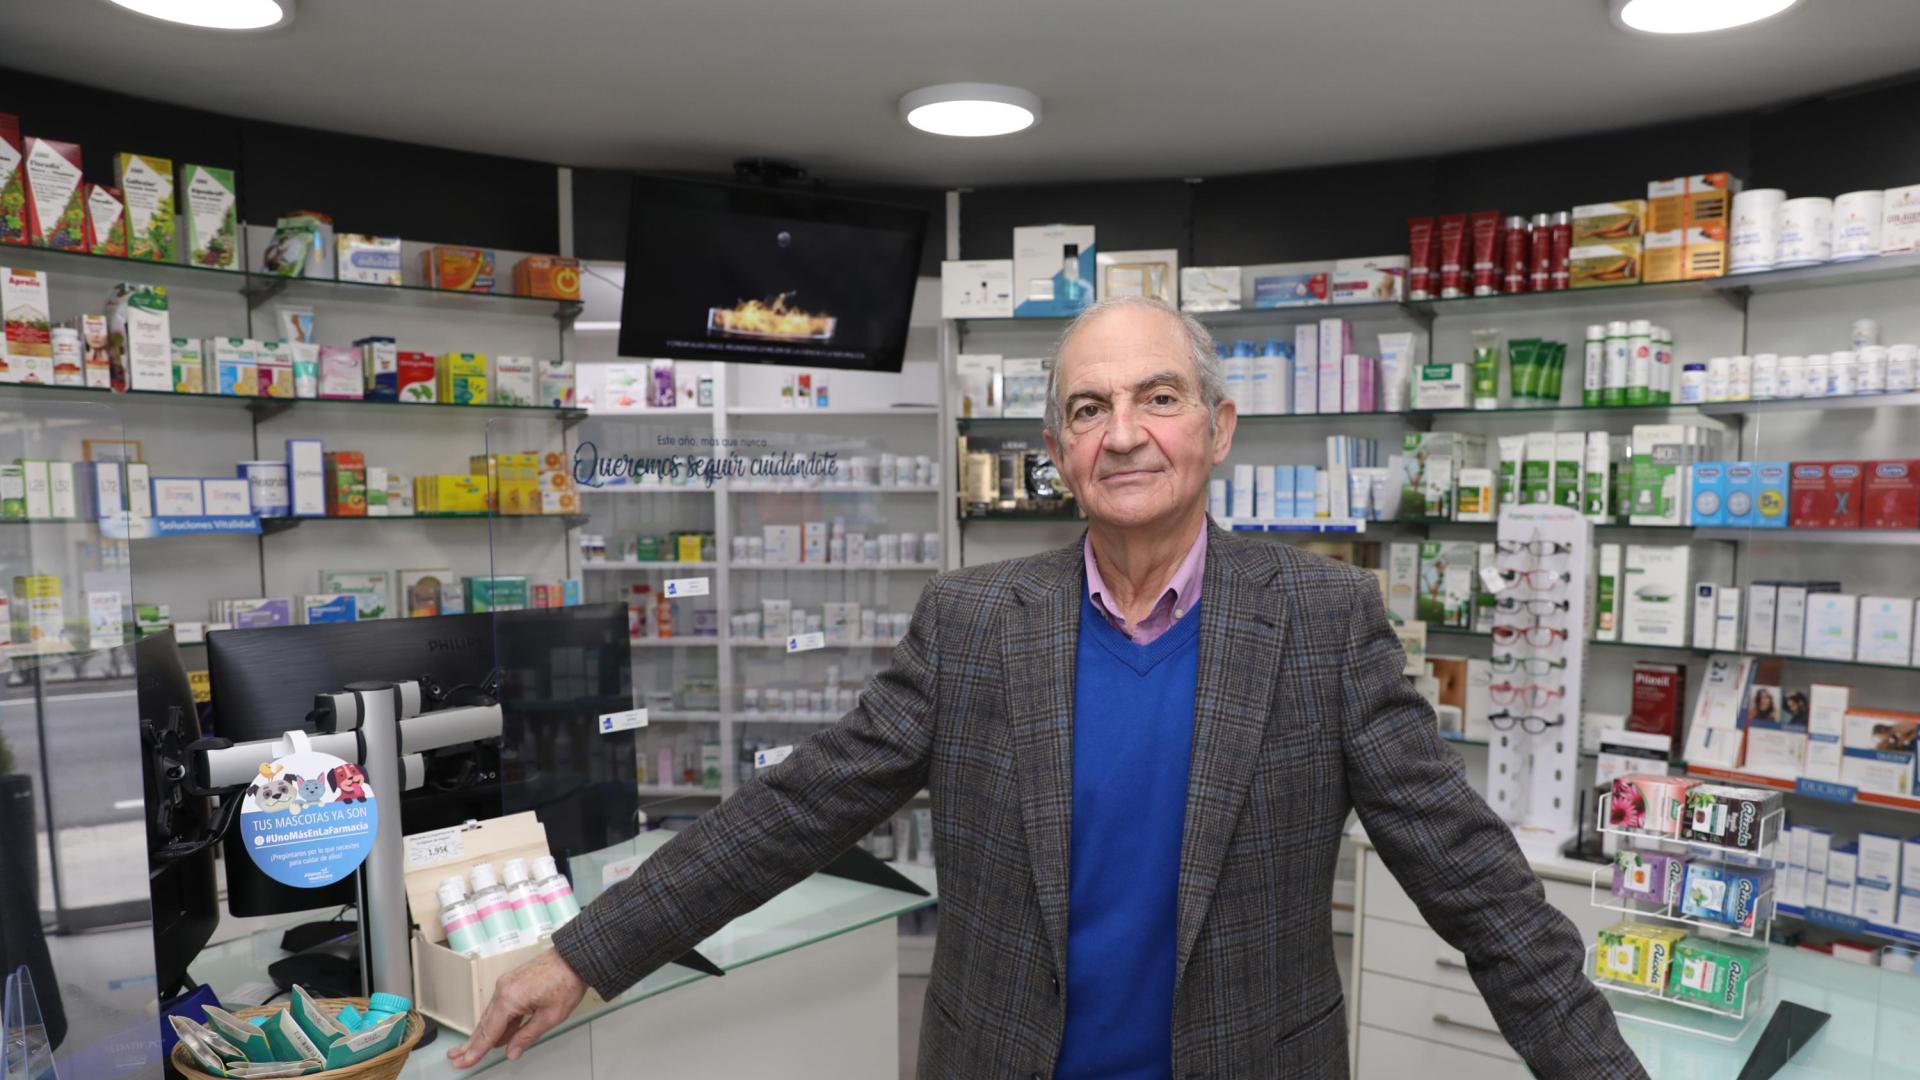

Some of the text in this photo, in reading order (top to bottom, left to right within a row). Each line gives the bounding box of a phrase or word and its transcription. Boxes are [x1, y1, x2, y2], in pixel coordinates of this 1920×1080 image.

[657, 435, 675, 446] Este
[678, 434, 697, 447] año,
[701, 435, 719, 447] más
[722, 438, 737, 449] que
[574, 441, 838, 488] Queremos seguir cuidándote
[159, 519, 257, 530] Soluciones Vitalidad
[428, 637, 482, 652] PHILIP
[252, 807, 367, 831] TUS MASCOTAS YA SON
[1738, 802, 1755, 845] Ricola
[1736, 879, 1752, 921] Ricola
[1650, 943, 1666, 985] Ricola
[1724, 961, 1742, 1004] Ricola
